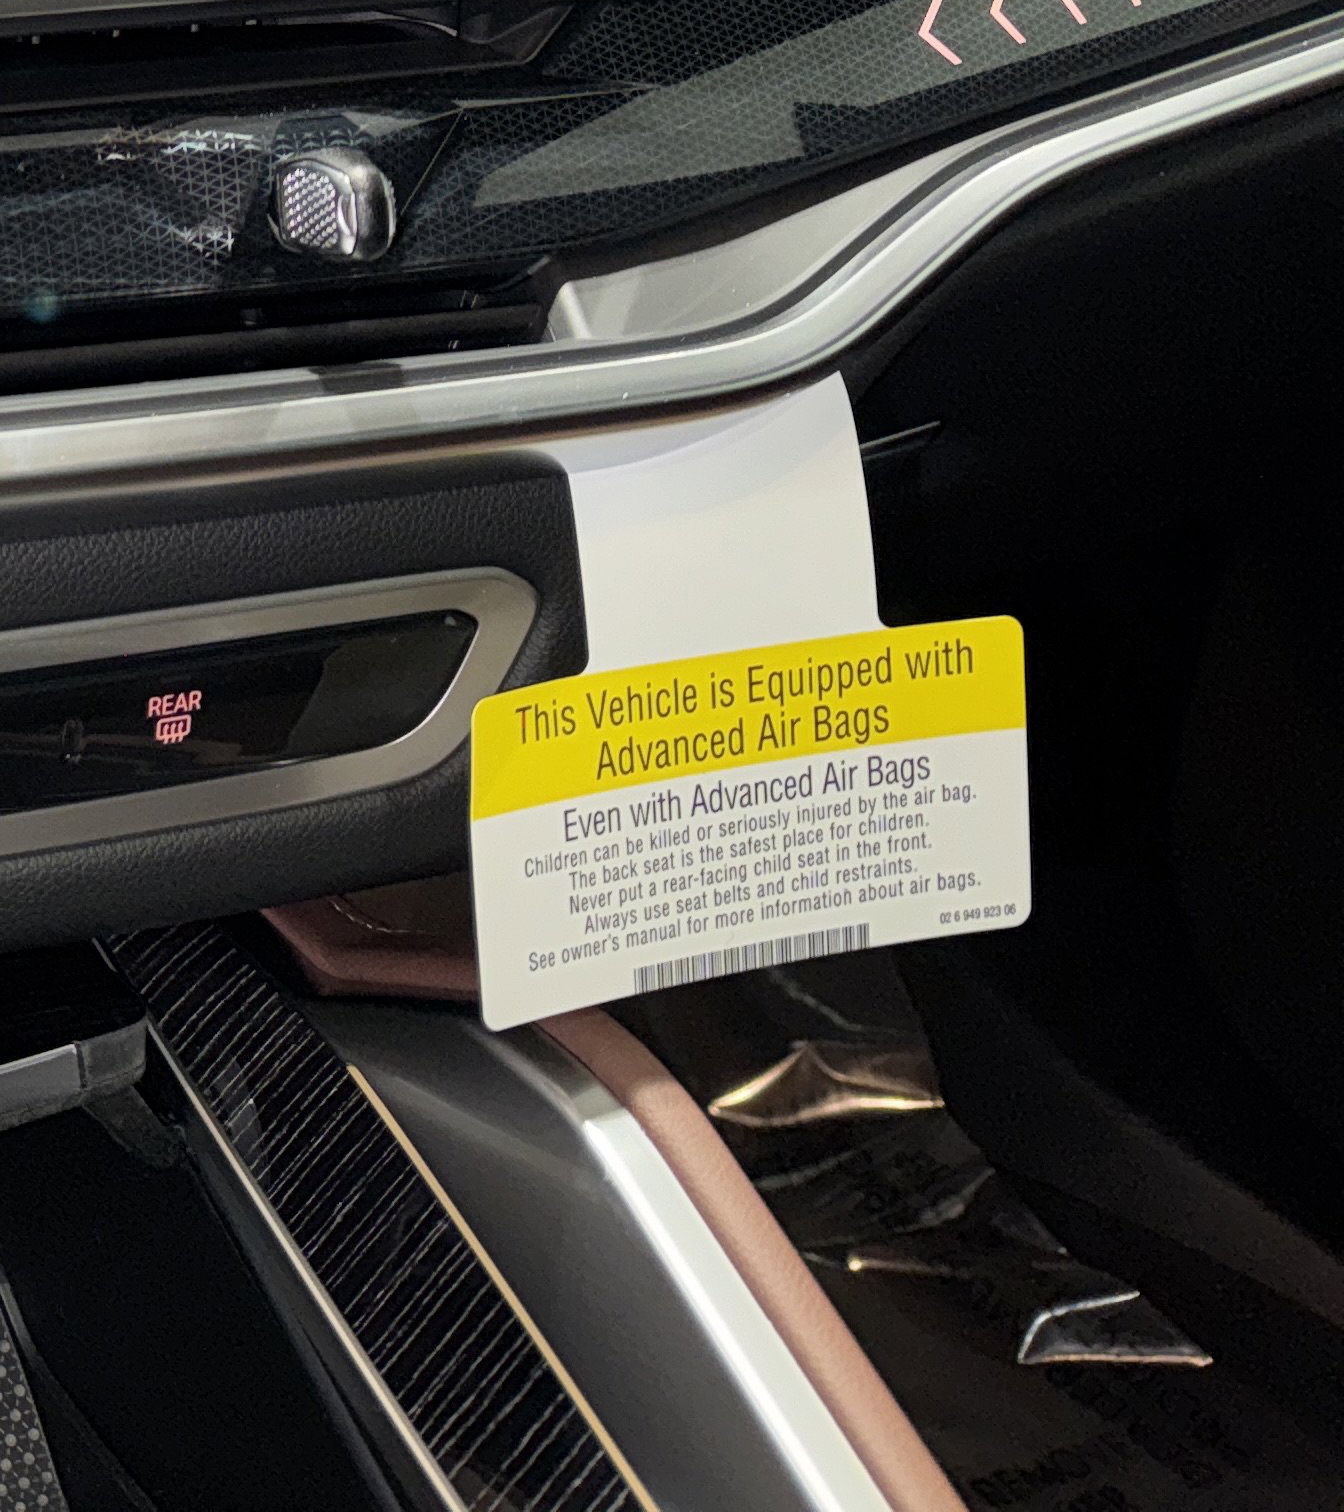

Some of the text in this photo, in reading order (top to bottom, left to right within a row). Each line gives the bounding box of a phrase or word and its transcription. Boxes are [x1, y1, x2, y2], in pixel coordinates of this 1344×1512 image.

[146, 689, 203, 718] REAR
[515, 638, 974, 745] This Vehicle is Equipped with
[596, 703, 890, 781] Advanced Air Bags
[524, 783, 977, 878] Children can be killed or seriously injured by the air bag.
[563, 754, 931, 843] Even with Advanced Air Bags
[569, 811, 930, 891] The back seat is the safest place for children.
[569, 831, 933, 915] Never put a rear-facing child seat in the front.
[528, 871, 982, 972] See owner's manual for more information about air bags.
[584, 857, 918, 935] Always use seat belts and child restraints.
